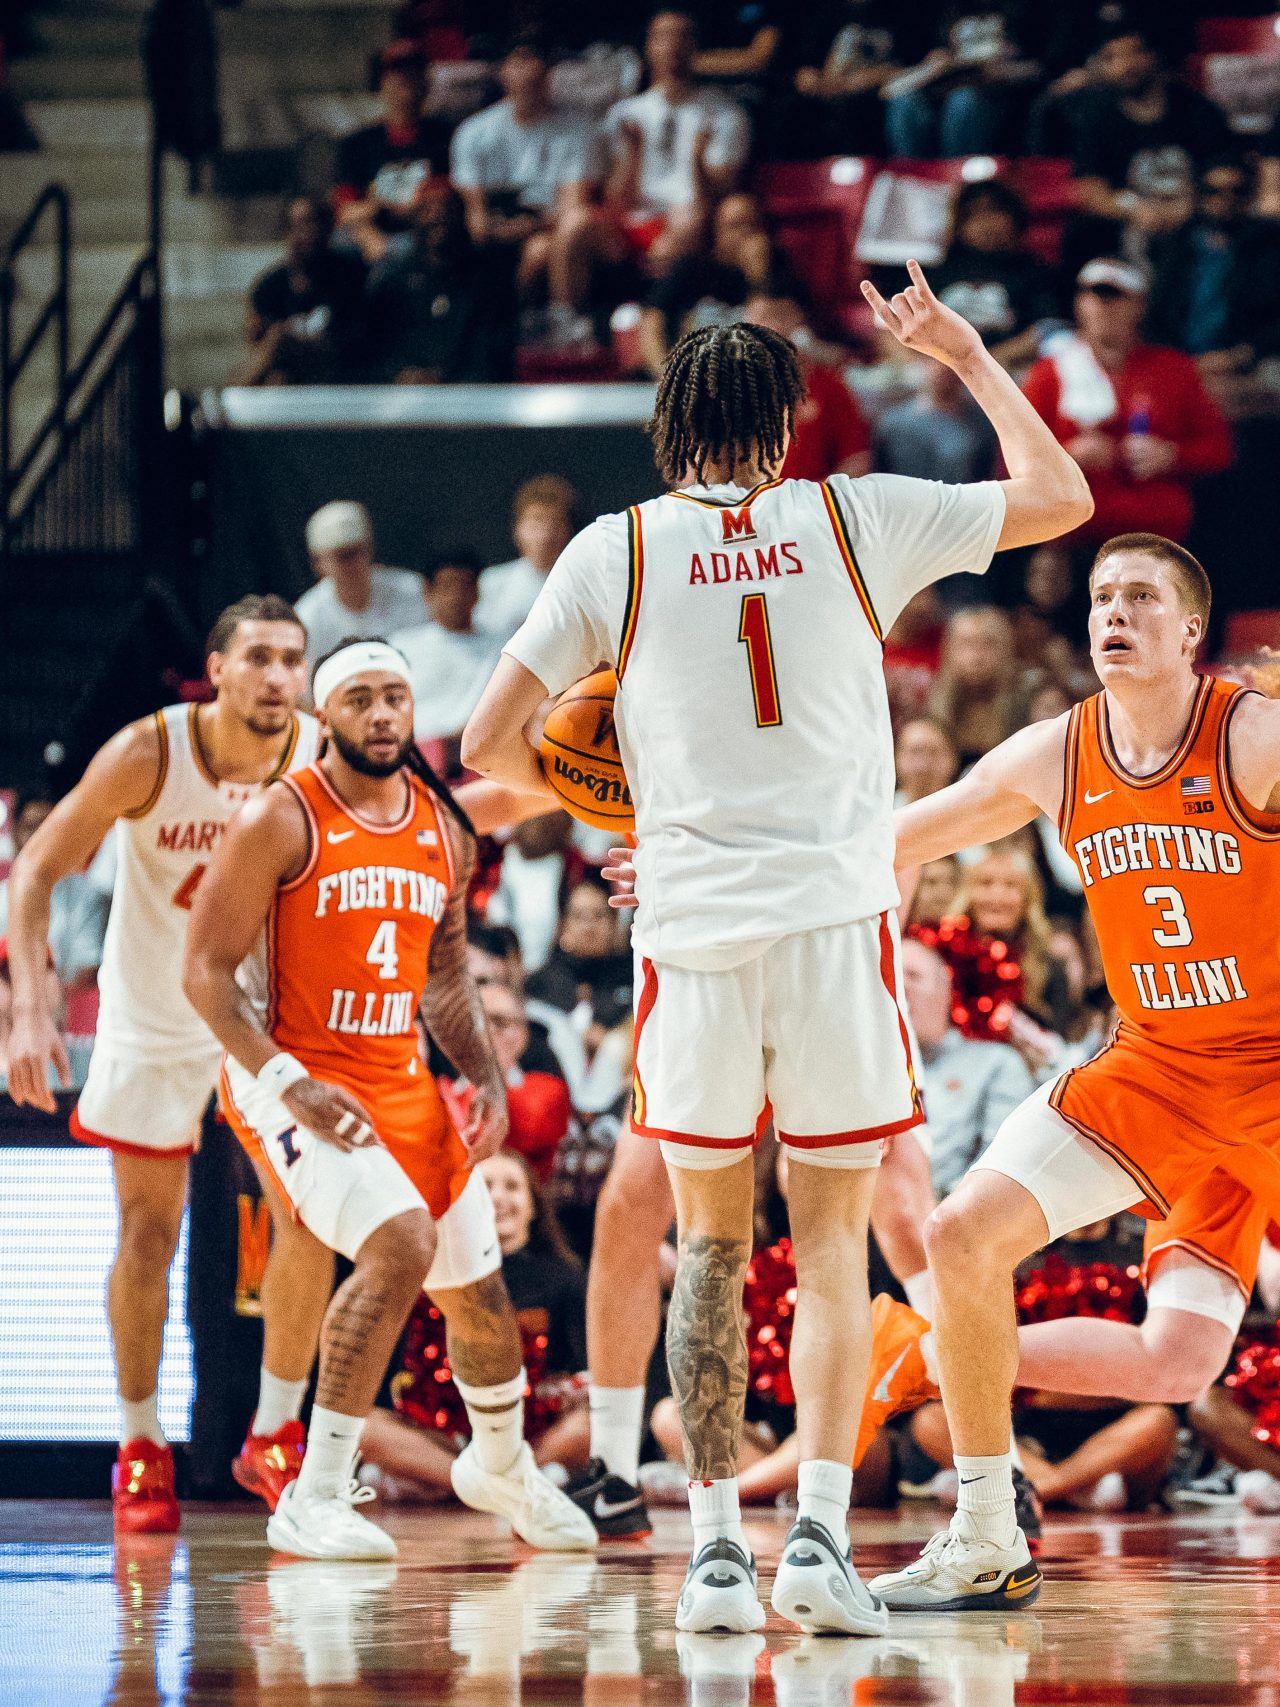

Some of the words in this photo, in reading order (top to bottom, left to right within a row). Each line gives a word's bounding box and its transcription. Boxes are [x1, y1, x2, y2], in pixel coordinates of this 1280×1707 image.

[719, 507, 757, 539] M
[689, 541, 804, 585] ADAMS
[738, 592, 783, 728] 1
[1074, 823, 1243, 888] FIGHTING
[314, 865, 448, 924] FIGHTING
[1142, 885, 1194, 948] 3
[365, 919, 399, 980] 4
[326, 988, 413, 1036] ILLINI
[1130, 956, 1248, 1010] ILLINI
